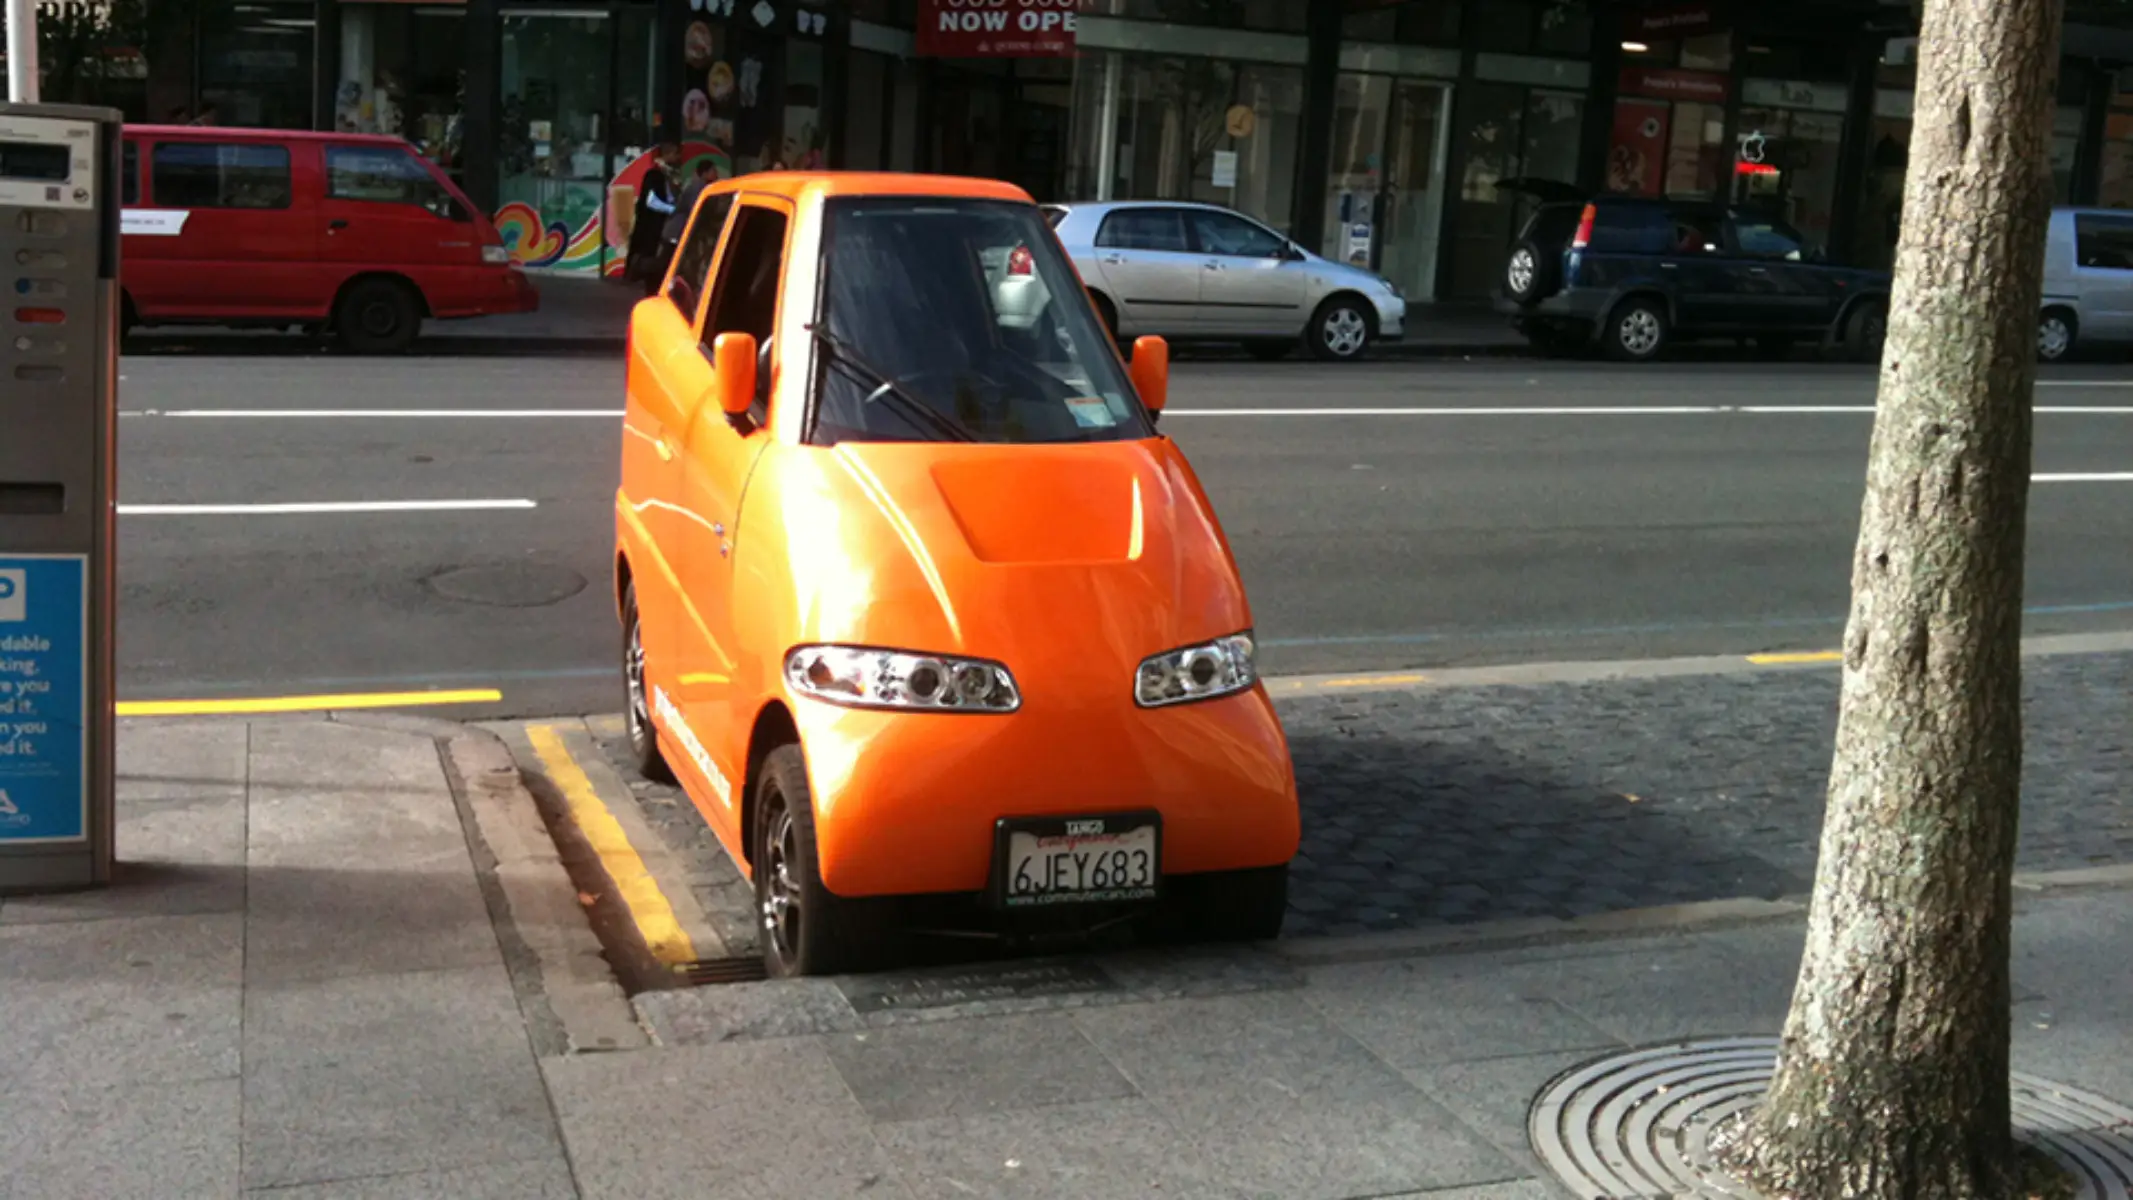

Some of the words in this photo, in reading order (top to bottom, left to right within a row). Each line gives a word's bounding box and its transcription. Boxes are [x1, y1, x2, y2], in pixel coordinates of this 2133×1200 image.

[939, 11, 1009, 32] NOW
[1018, 11, 1077, 32] OPE
[15, 680, 51, 697] you
[12, 722, 48, 740] you
[1014, 849, 1150, 895] 6JEY683
[1006, 888, 1156, 905] www.commutercars.com
